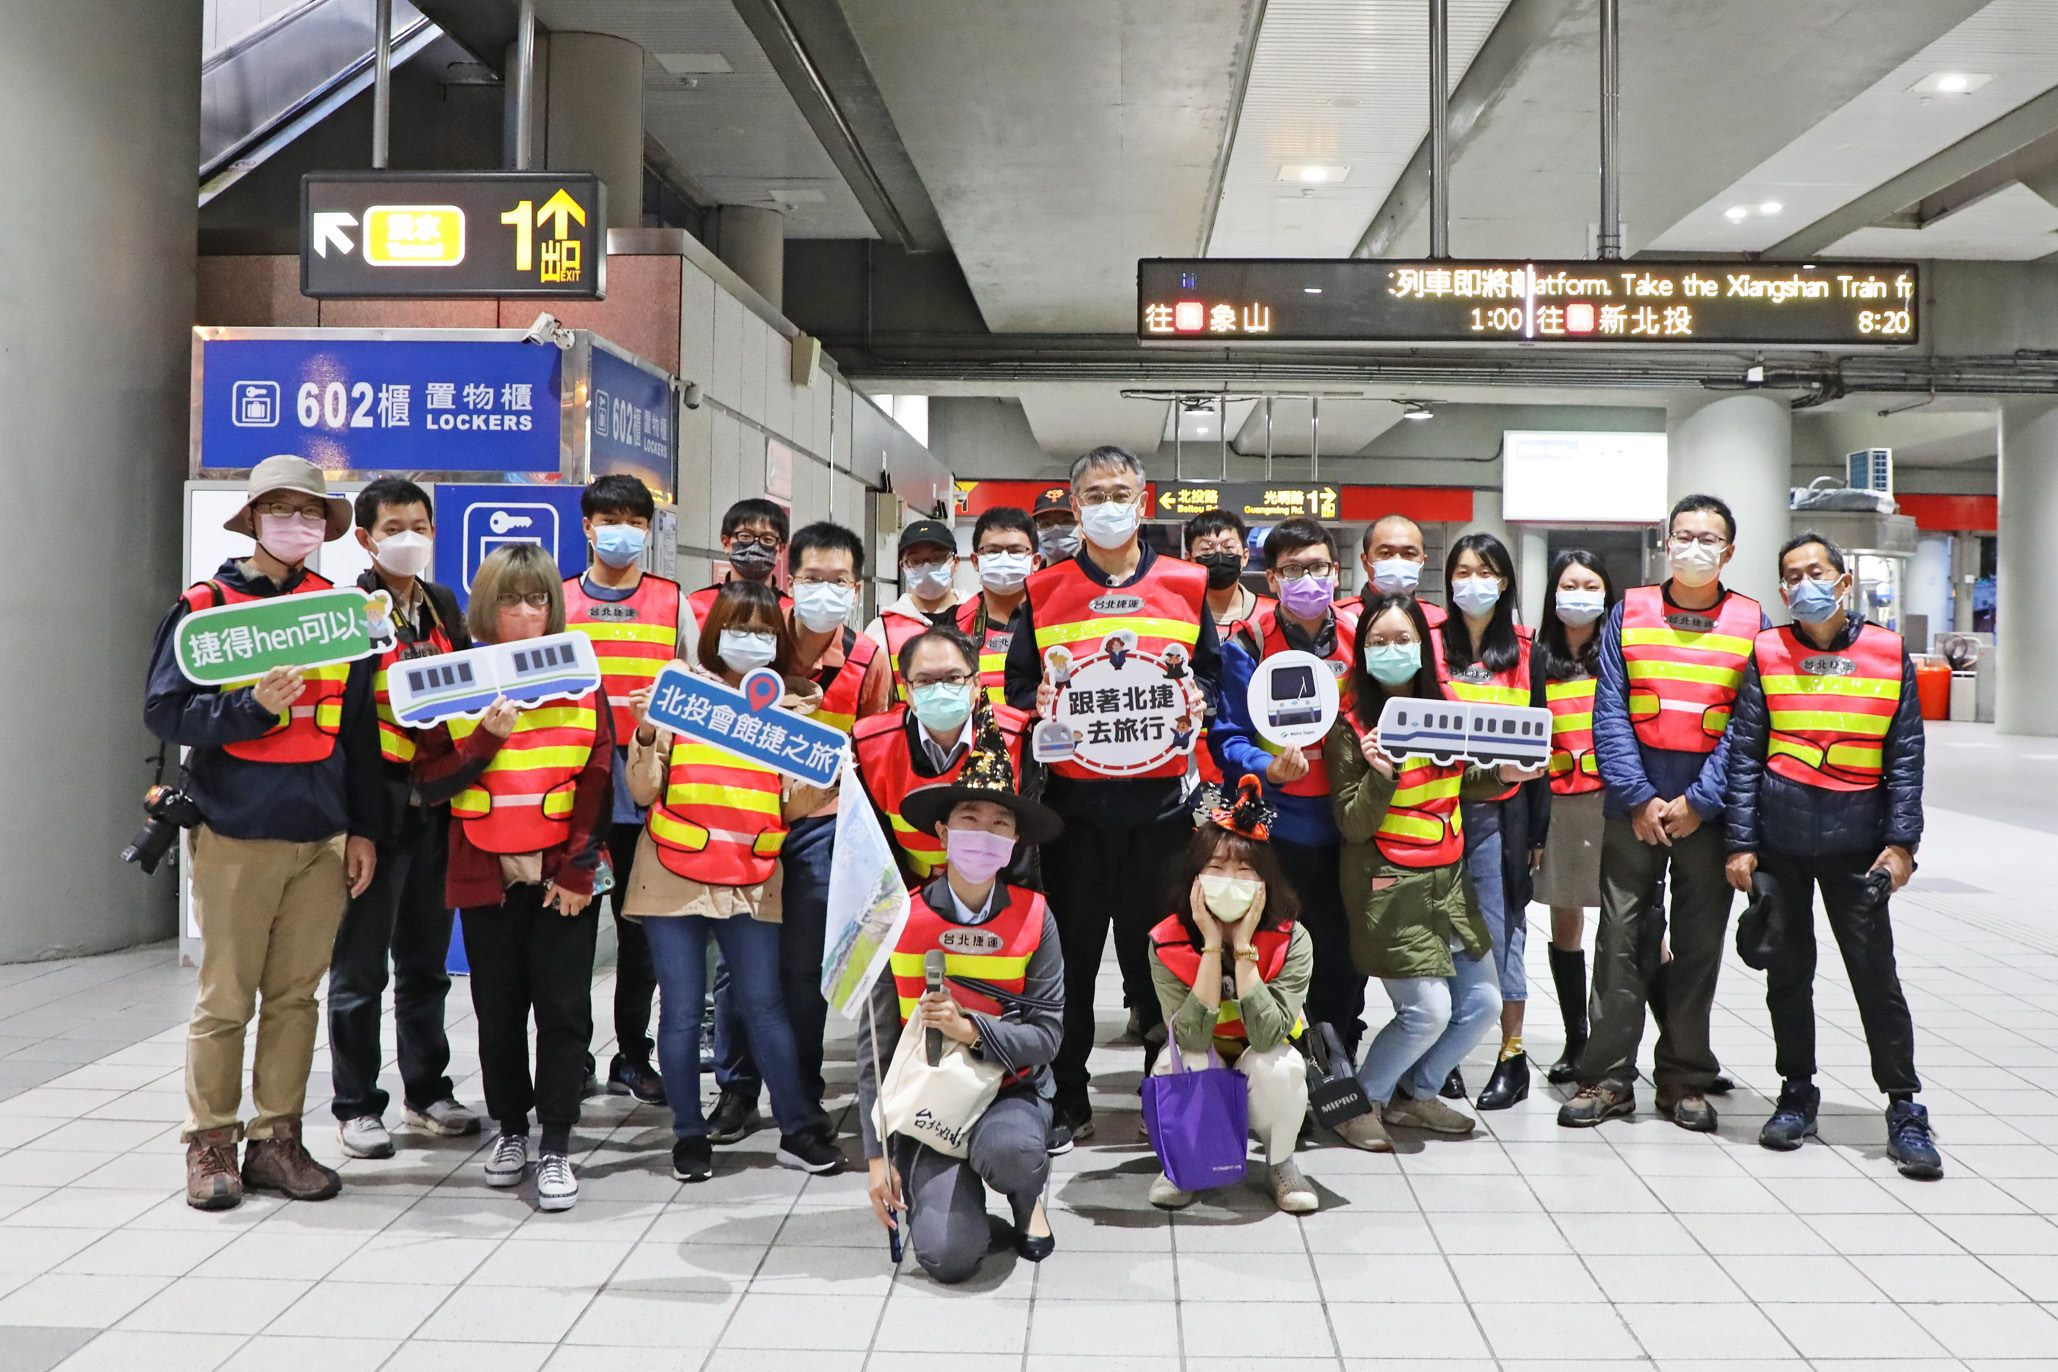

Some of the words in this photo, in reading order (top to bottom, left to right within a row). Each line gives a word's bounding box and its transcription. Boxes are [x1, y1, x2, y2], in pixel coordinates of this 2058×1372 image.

[501, 200, 532, 271] 1
[540, 240, 581, 283] 出口
[560, 270, 581, 282] EXIT
[1621, 272, 1674, 297] Take
[1682, 272, 1719, 297] the
[1726, 273, 1829, 304] Xiangshan
[1836, 275, 1887, 299] Train
[1471, 307, 1523, 331] 1:00
[1858, 310, 1911, 334] 8:20
[425, 383, 533, 412] 置物櫃
[426, 413, 533, 432] LOCKERS
[188, 607, 363, 668] 捷得hen可以
[1068, 683, 1175, 716] 跟著北捷
[656, 685, 842, 774] 北投會館捷之旅
[1087, 716, 1166, 744] 去旅行
[943, 933, 999, 948] 台北捷運
[1321, 1092, 1358, 1113] MIPRO
